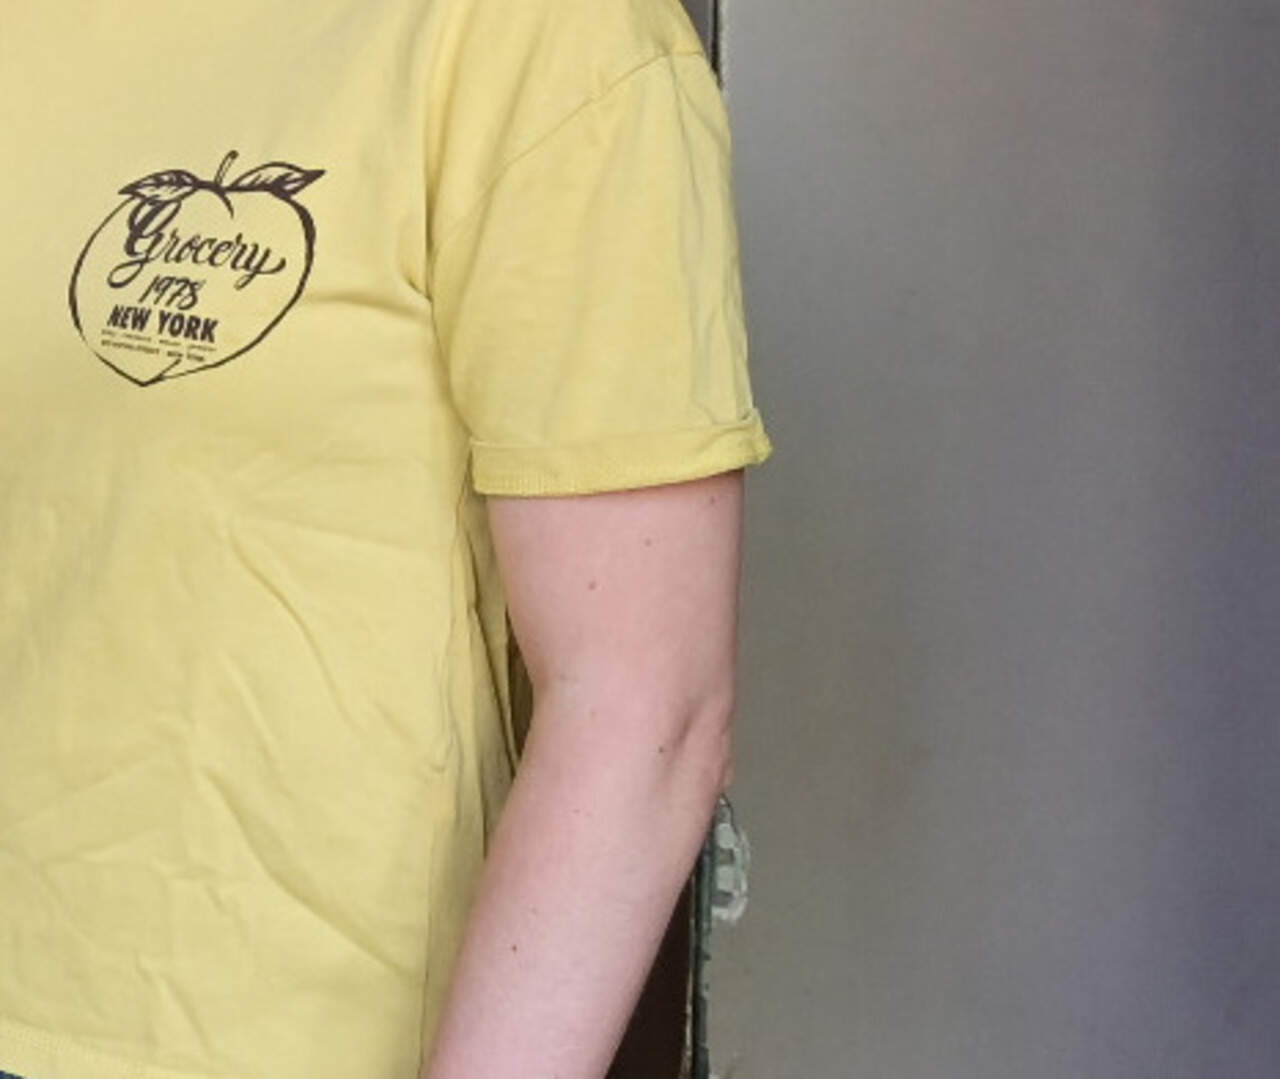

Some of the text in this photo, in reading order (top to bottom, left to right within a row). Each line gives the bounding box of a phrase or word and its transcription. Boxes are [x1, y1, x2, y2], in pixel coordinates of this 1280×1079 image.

[107, 195, 287, 290] Grocery
[106, 304, 152, 332] NEW
[158, 309, 219, 344] YORK
